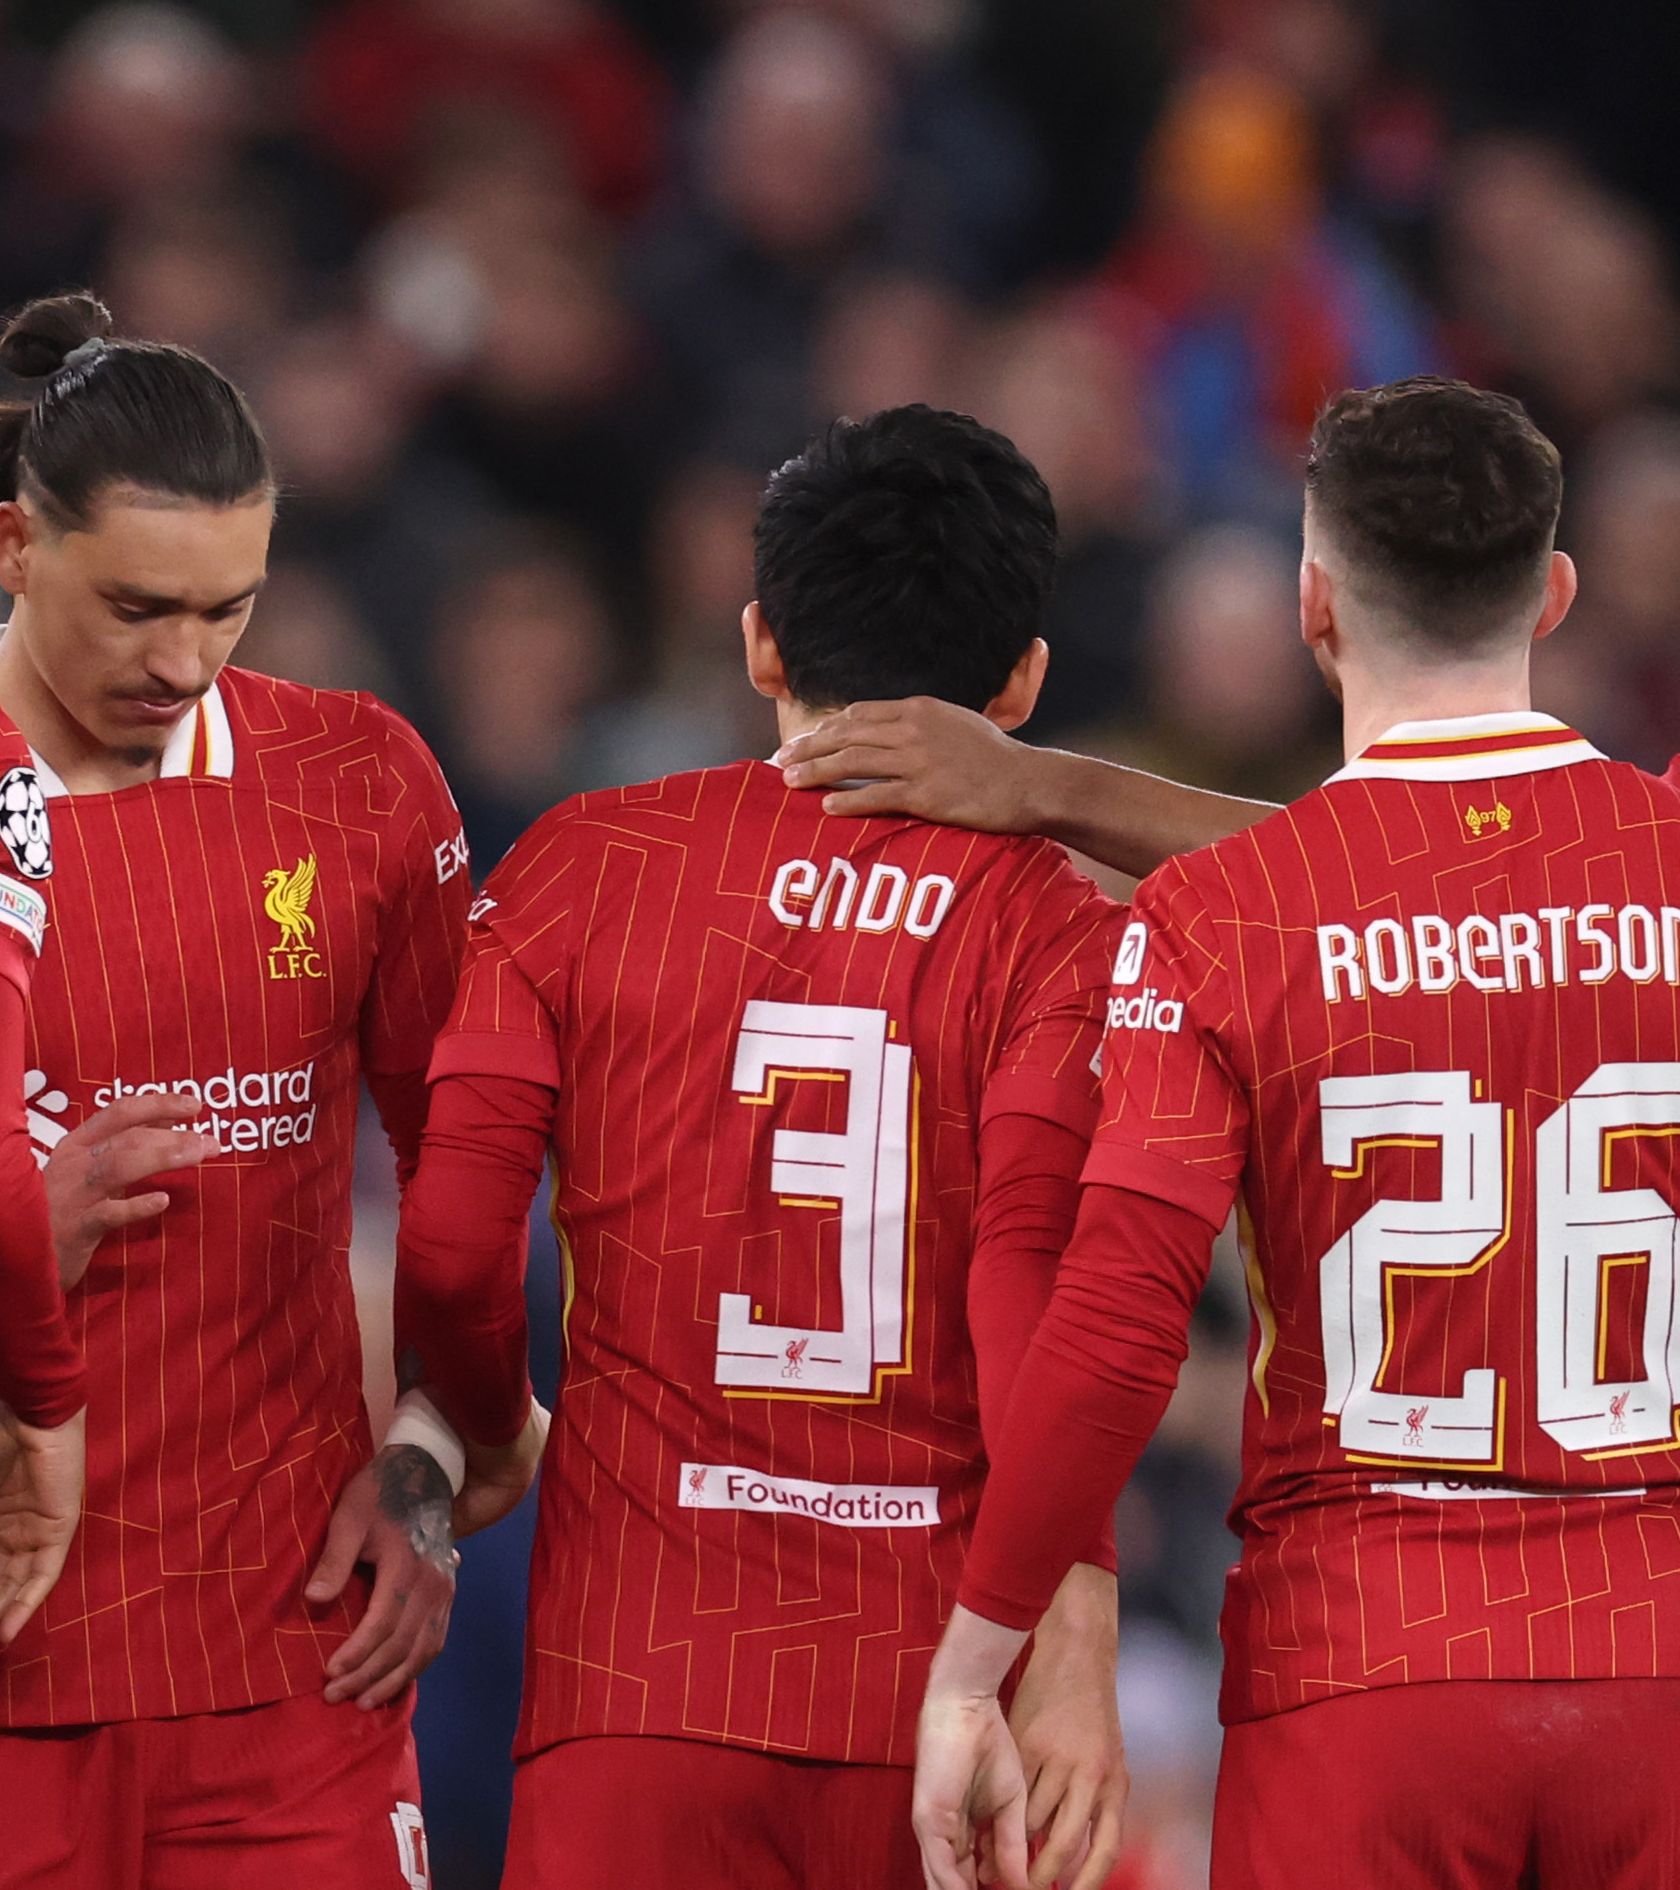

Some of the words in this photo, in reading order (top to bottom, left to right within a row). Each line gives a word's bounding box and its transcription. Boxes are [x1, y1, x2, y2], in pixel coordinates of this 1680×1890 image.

[1479, 810, 1496, 823] 97
[1316, 894, 1680, 1004] ROBERTSON
[715, 999, 922, 1404] 3
[1318, 1061, 1680, 1472] 26
[726, 1474, 925, 1522] Foundation
